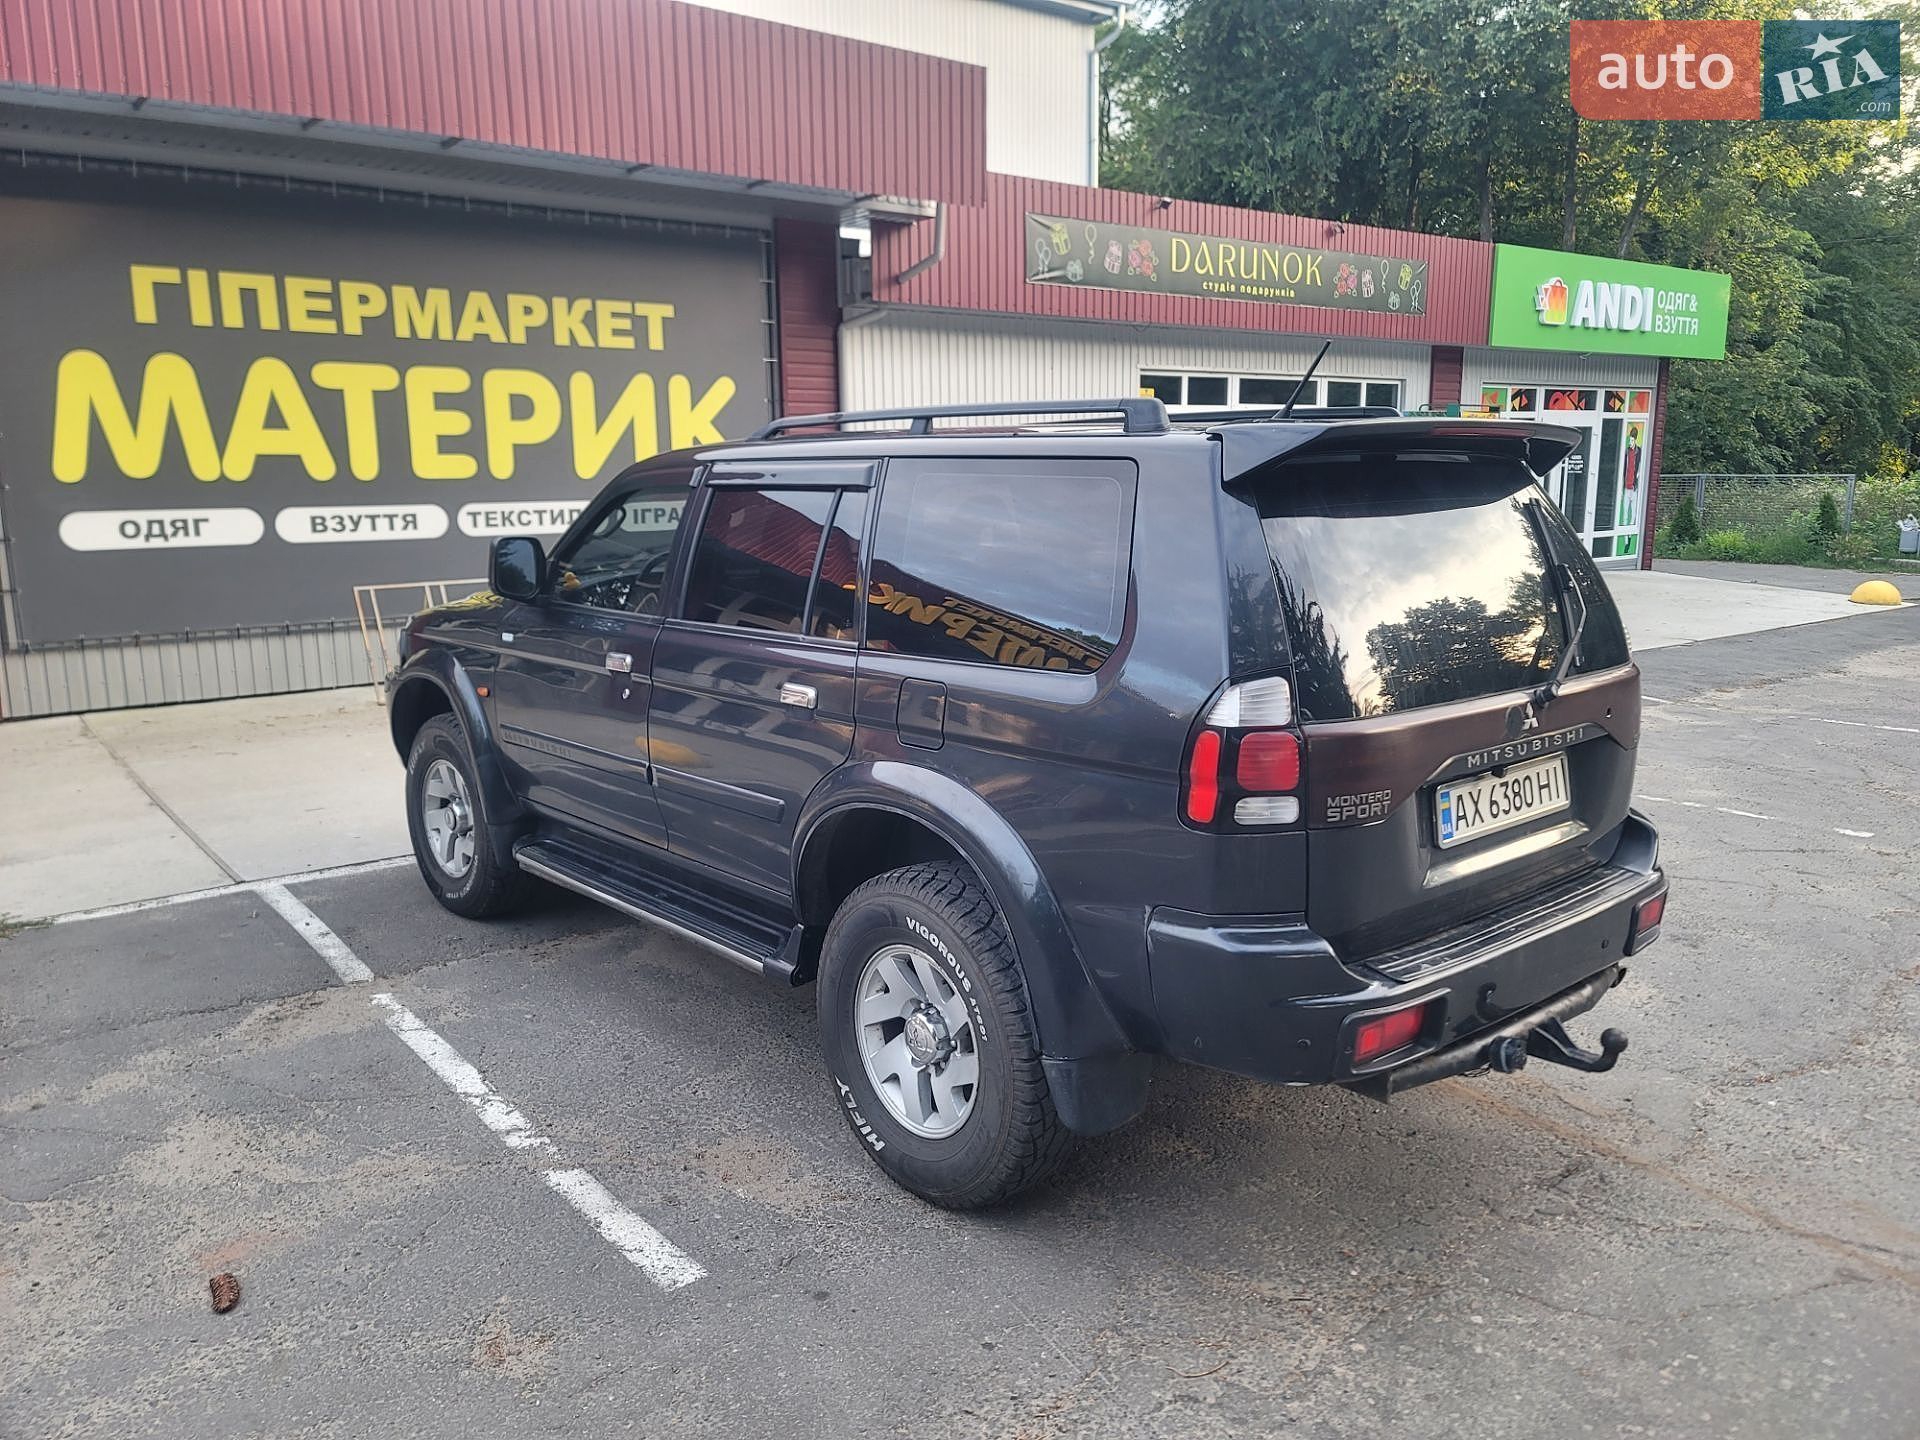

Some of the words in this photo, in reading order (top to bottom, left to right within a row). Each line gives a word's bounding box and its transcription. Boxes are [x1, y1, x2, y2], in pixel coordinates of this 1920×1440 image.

[1171, 238, 1323, 286] DARUNOK
[1202, 281, 1236, 293] студія
[1240, 284, 1296, 298] подарунків
[130, 264, 675, 351] ГІПЕРМАРКЕТ
[1570, 280, 1654, 332] ANDI
[1655, 315, 1699, 336] ВЗУТТЯ
[52, 348, 736, 483] МАТЕРИК
[119, 516, 210, 541] ОДЯГ
[310, 512, 419, 535] ВЗУТТЯ
[467, 508, 582, 528] ТЕКСТИЛ
[632, 507, 681, 525] ІГРА
[1467, 728, 1585, 768] MITSUBISHI
[1327, 790, 1391, 807] MONTERO
[1327, 801, 1391, 821] SPORT
[1455, 787, 1485, 832] AX
[1490, 775, 1534, 818] 6380
[1536, 766, 1560, 804] HI
[905, 916, 972, 993] VIGOROUS
[834, 1075, 886, 1152] HIFLY
